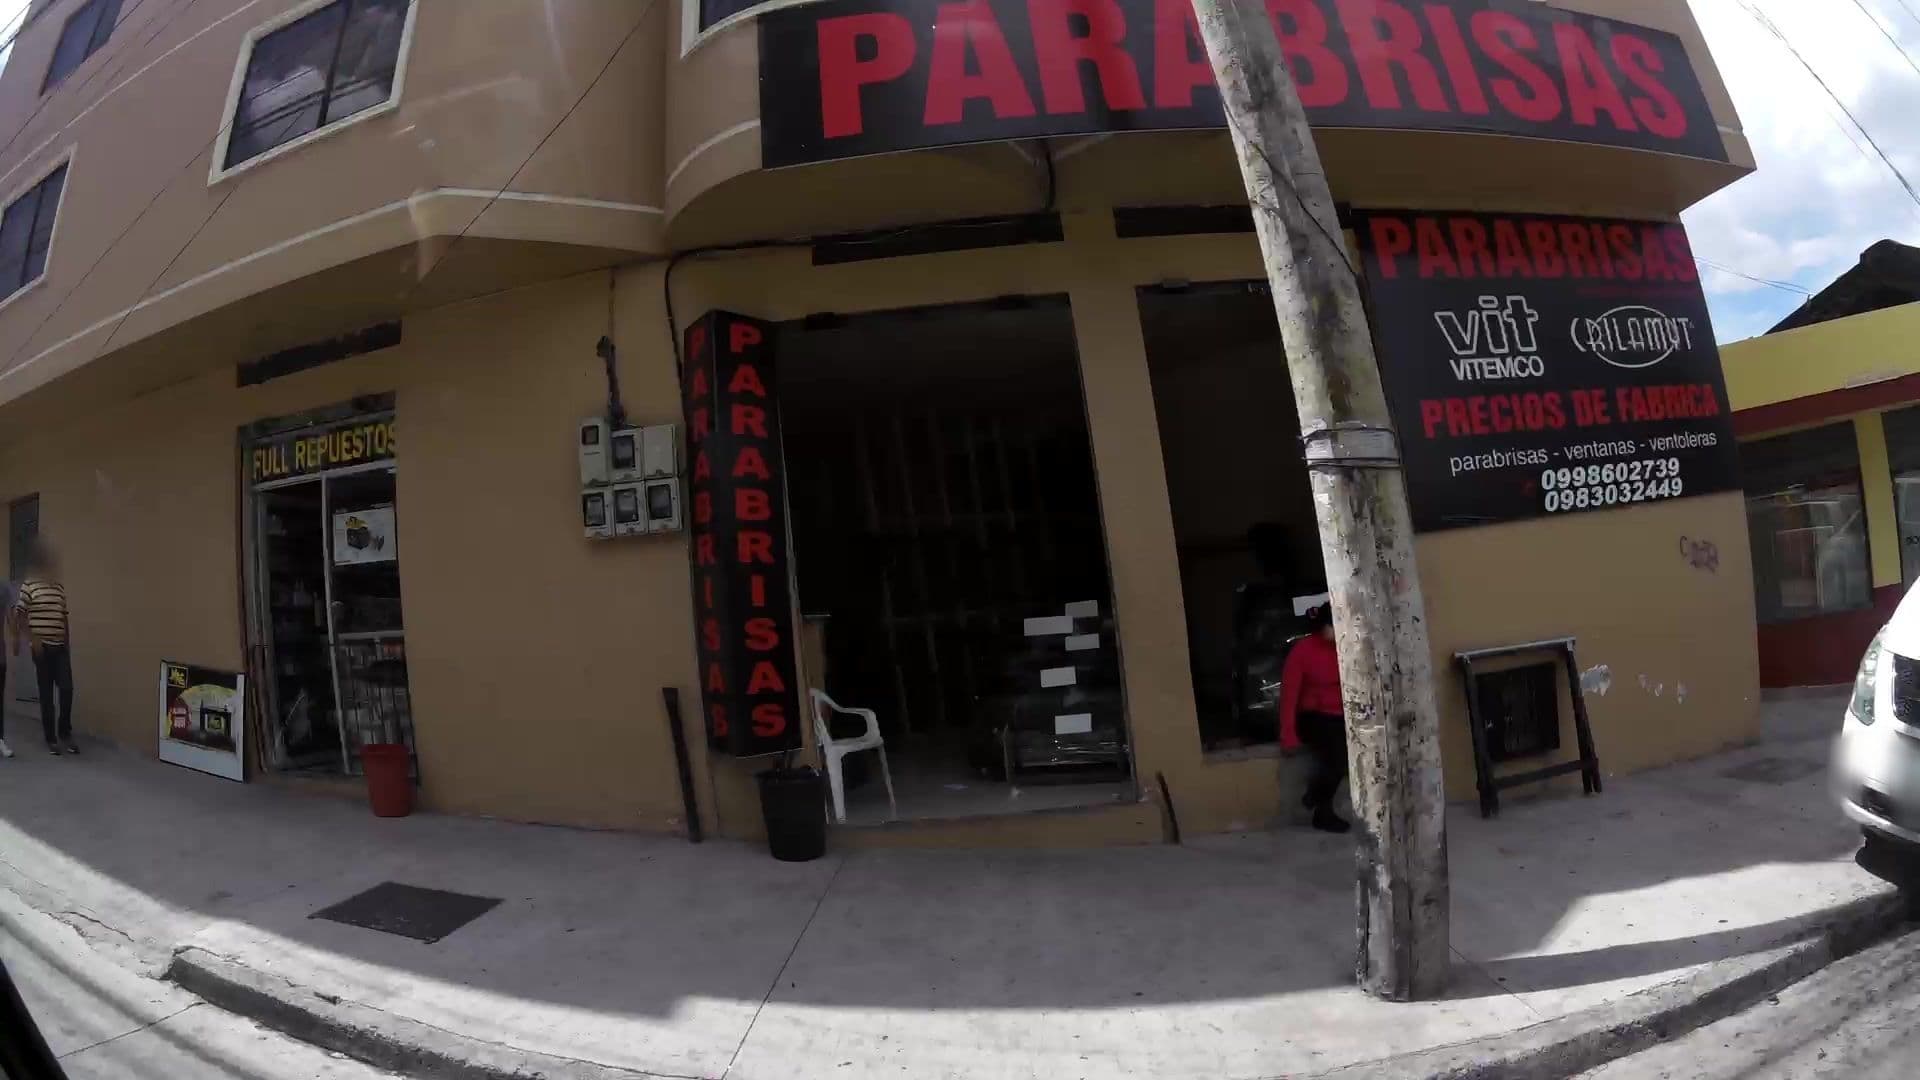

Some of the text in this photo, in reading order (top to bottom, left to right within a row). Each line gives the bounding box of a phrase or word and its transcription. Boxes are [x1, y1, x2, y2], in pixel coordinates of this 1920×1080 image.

[1368, 216, 1697, 283] PARABRISAS
[1434, 295, 1539, 355] vit
[1450, 355, 1545, 381] VITEMCO
[1420, 383, 1719, 439] PRECIOS DE FABRICA
[253, 423, 396, 480] FULL REPUESTOS
[1450, 447, 1549, 477] parabrisas
[1564, 438, 1636, 461] ventanas
[1649, 430, 1718, 452] ventoleras
[1541, 457, 1680, 490] 0998602739
[1544, 478, 1683, 512] 0983032449
[728, 321, 786, 738] PARABRISAS
